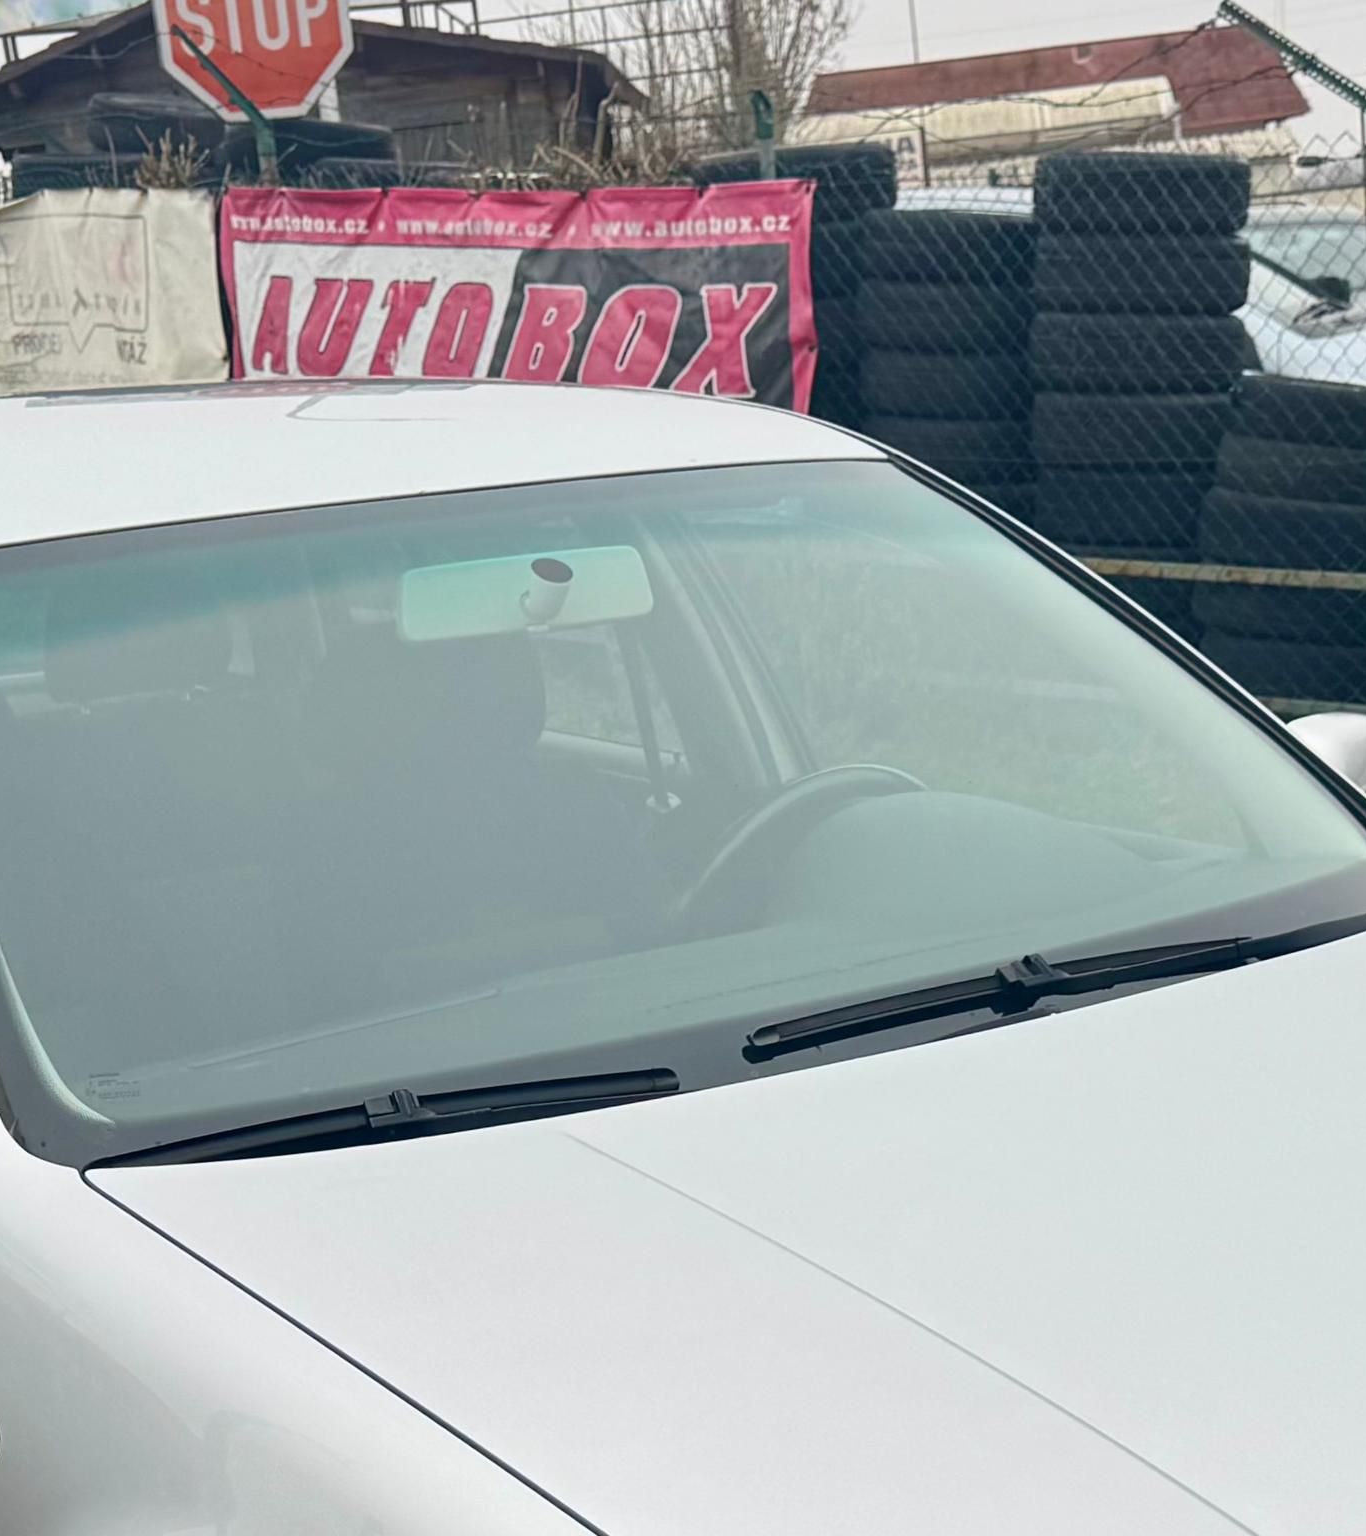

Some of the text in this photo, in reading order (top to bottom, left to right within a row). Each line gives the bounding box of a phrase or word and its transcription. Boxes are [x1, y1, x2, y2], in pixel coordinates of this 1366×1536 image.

[174, 0, 327, 57] STOP
[230, 213, 791, 239] www.autobox.cz www.autobox.cz www.autobox.cz
[251, 275, 777, 398] AUTOBOX
